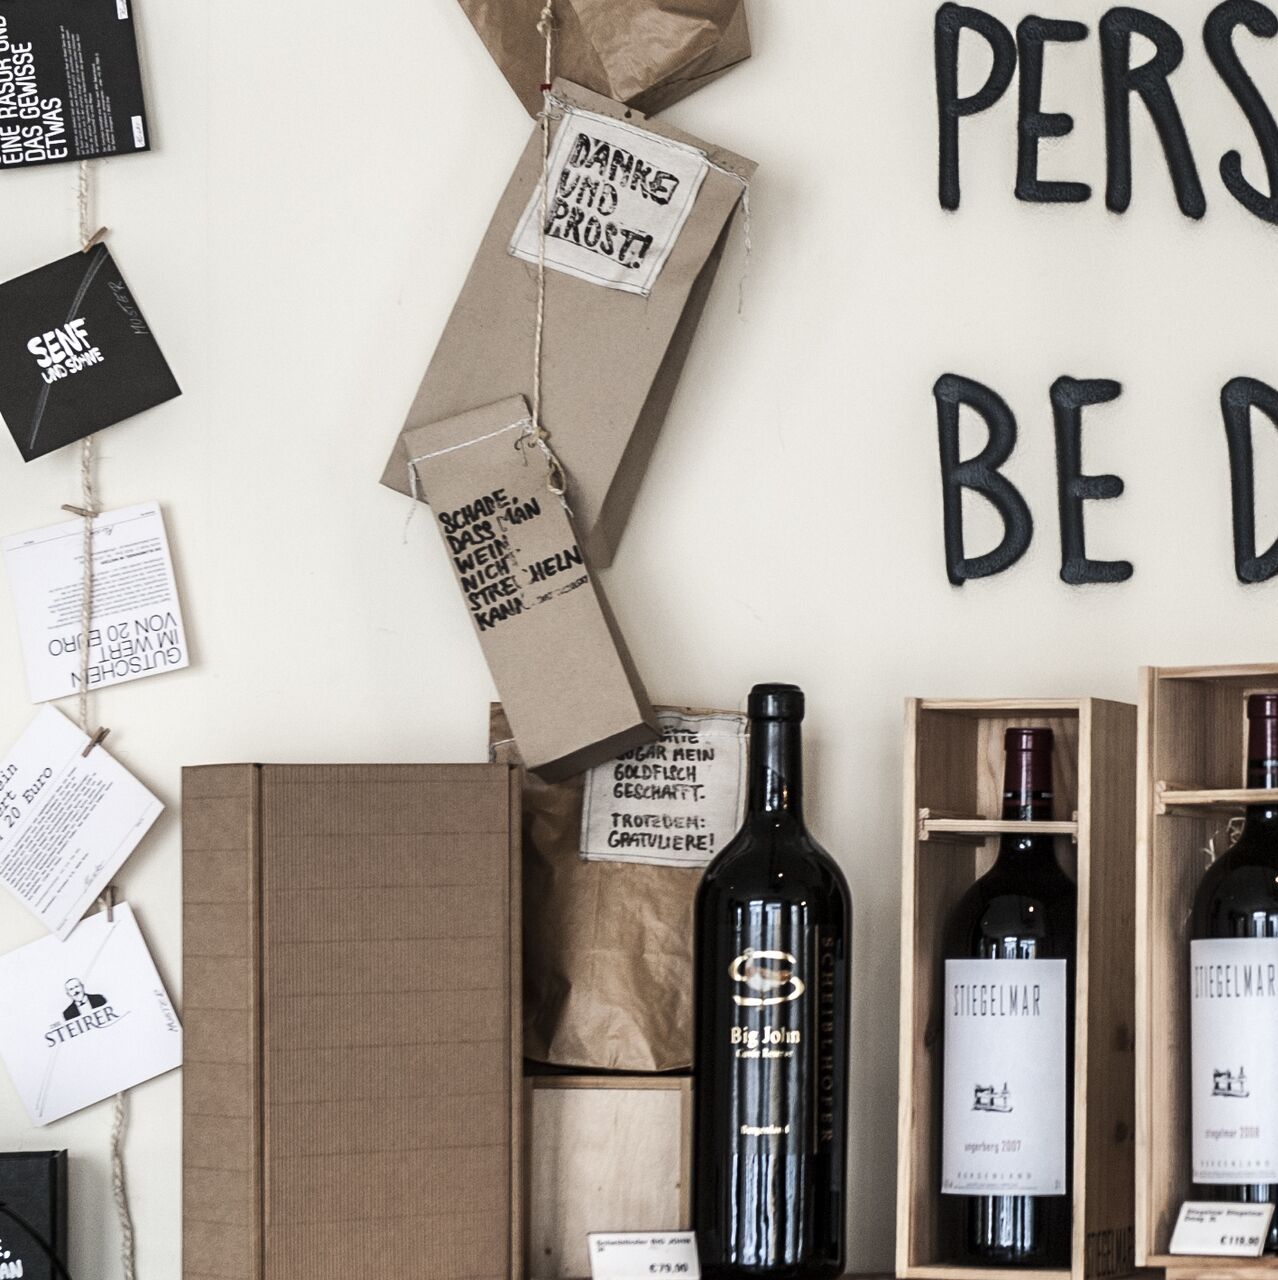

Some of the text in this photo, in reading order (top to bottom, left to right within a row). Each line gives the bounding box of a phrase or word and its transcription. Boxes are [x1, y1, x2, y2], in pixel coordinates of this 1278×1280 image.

[11, 41, 47, 162] DAS GEWISSE
[40, 97, 69, 160] ETWAS
[570, 132, 680, 206] DANKE
[556, 168, 619, 216] UND
[107, 279, 151, 335] MUSTER
[27, 317, 91, 369] SENF
[41, 363, 68, 384] UND
[932, 372, 1134, 588] BE
[446, 520, 496, 555] DASS
[453, 534, 510, 575] WEIN
[106, 611, 178, 642] 20 VON
[613, 763, 697, 783] GOLDFISCH
[672, 748, 715, 762] MEIN
[22, 767, 53, 804] Euro
[4, 806, 21, 829] 20
[1194, 963, 1276, 999] STIEGELMAR
[954, 983, 1041, 1017] STIEGELMAR
[44, 1006, 121, 1048] STEIRER
[730, 1025, 759, 1049] Big
